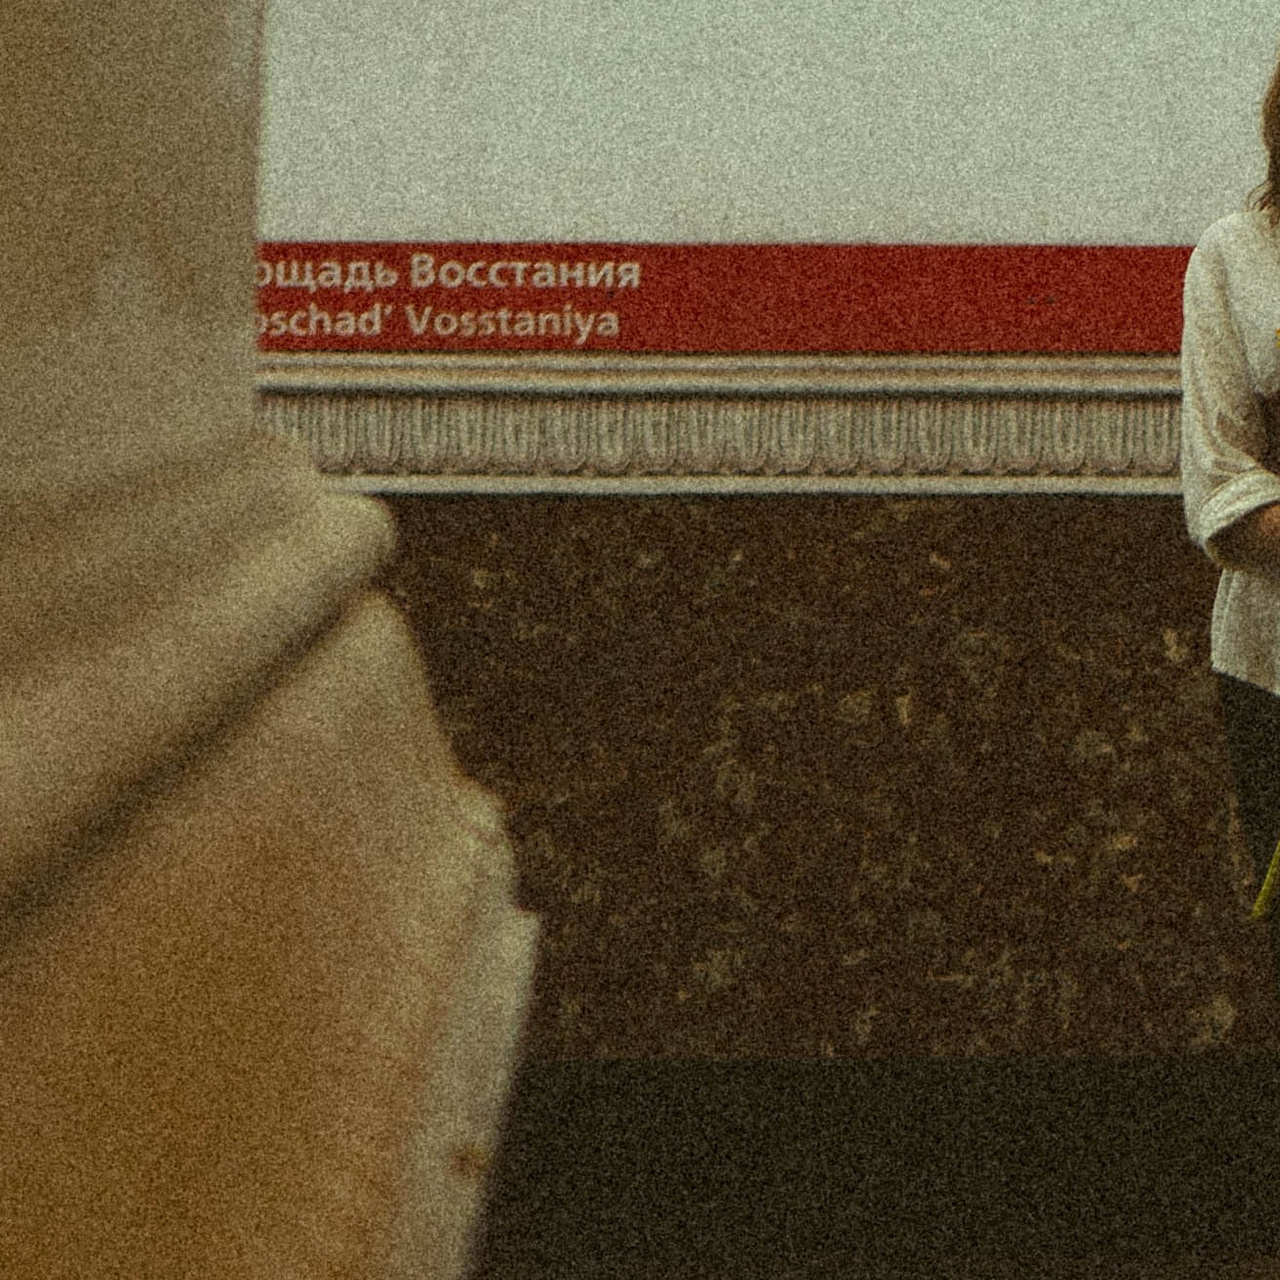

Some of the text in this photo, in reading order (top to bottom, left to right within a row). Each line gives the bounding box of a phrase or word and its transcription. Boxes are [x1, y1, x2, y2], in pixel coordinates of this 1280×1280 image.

[254, 252, 642, 293] ощадь Восстания
[254, 302, 620, 345] oschad' Vosstaniya
